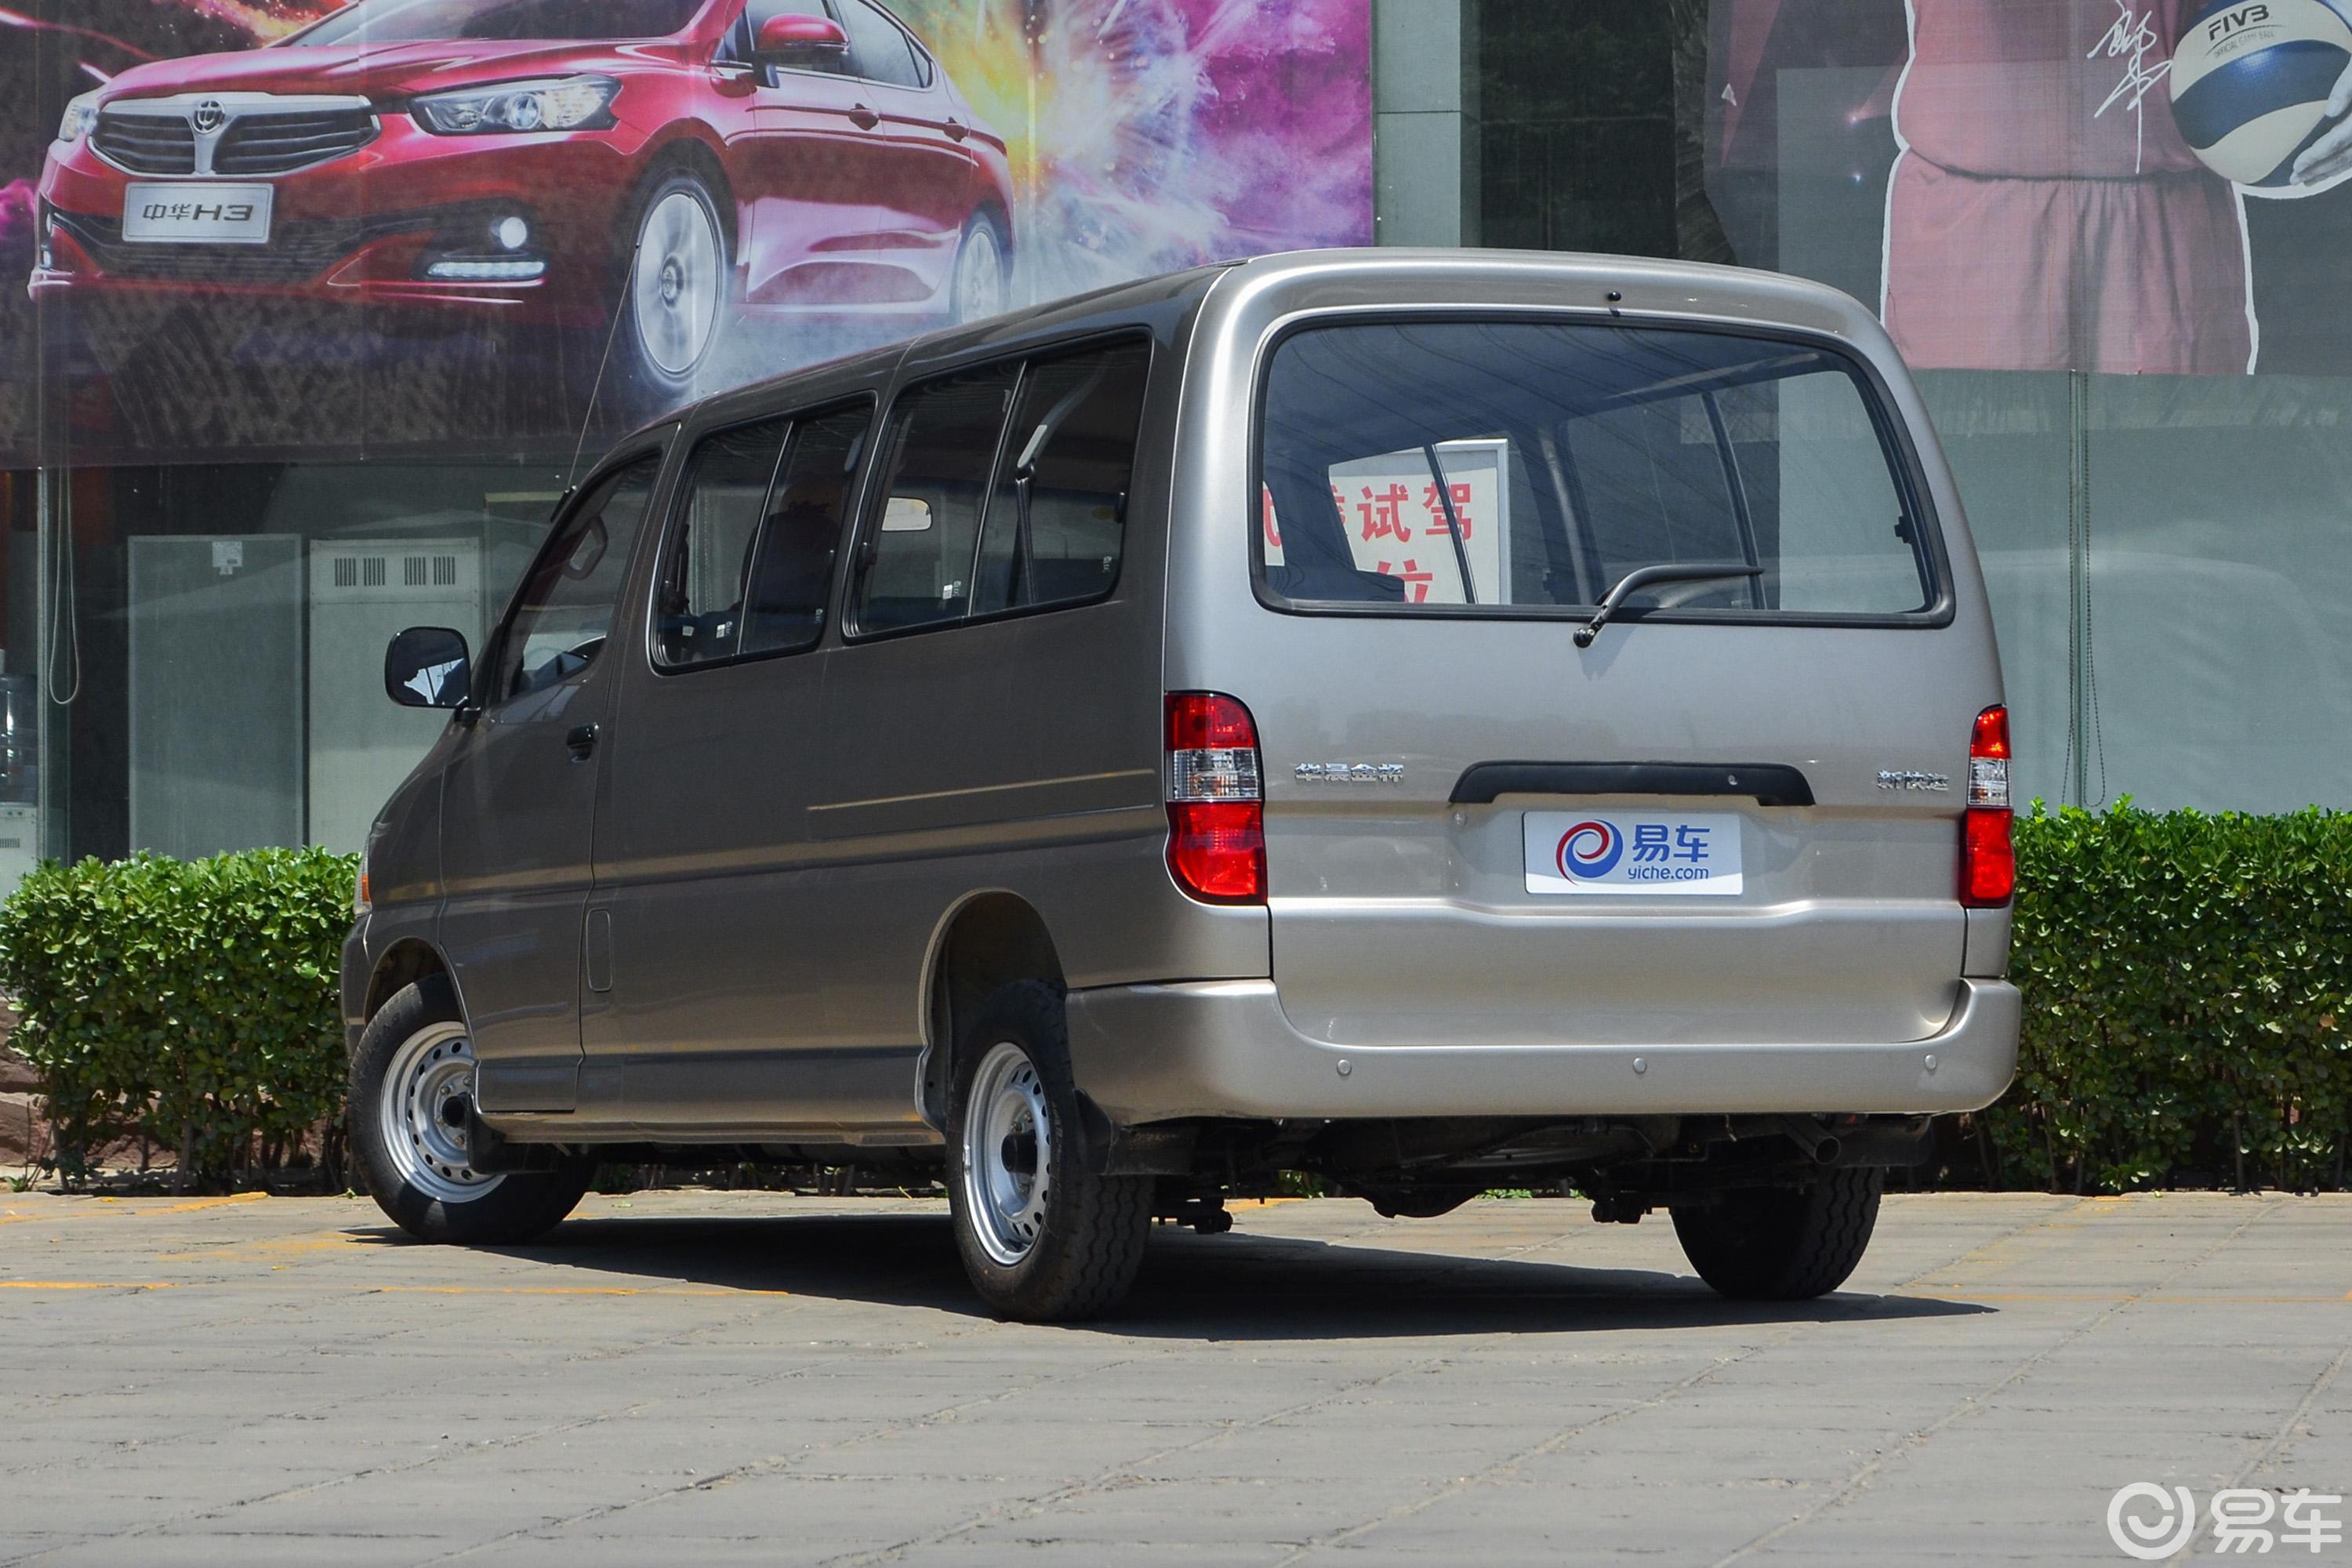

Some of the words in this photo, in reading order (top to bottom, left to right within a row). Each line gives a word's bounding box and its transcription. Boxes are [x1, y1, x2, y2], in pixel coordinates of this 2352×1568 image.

[2208, 4, 2269, 41] FIVB
[142, 204, 254, 221] 中华H3
[1294, 763, 1404, 782] 华晨金杯
[1632, 824, 1711, 862] 易车
[1628, 866, 1709, 880] yiche.com
